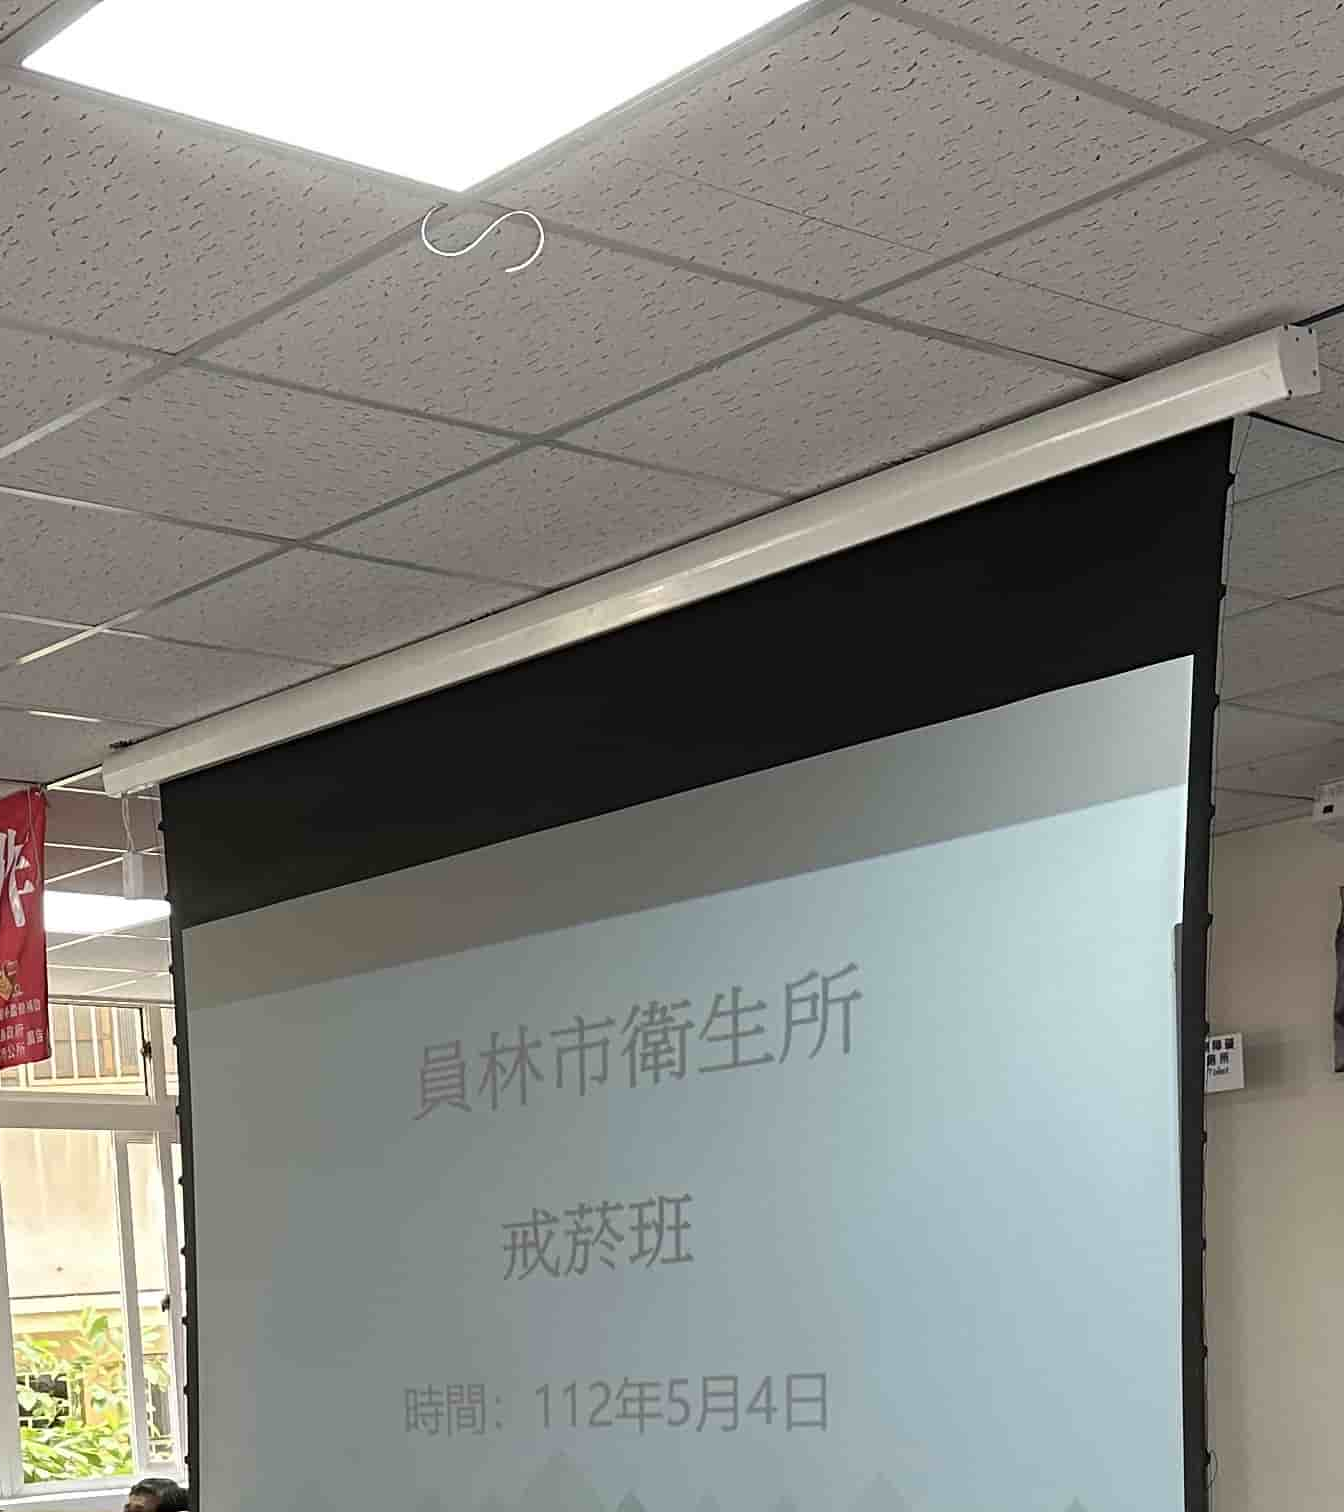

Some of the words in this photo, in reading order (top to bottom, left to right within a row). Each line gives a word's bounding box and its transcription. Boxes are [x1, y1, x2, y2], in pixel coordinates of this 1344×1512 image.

[412, 960, 863, 1121] 員林市衛生所
[502, 1191, 695, 1281] 戒菸班
